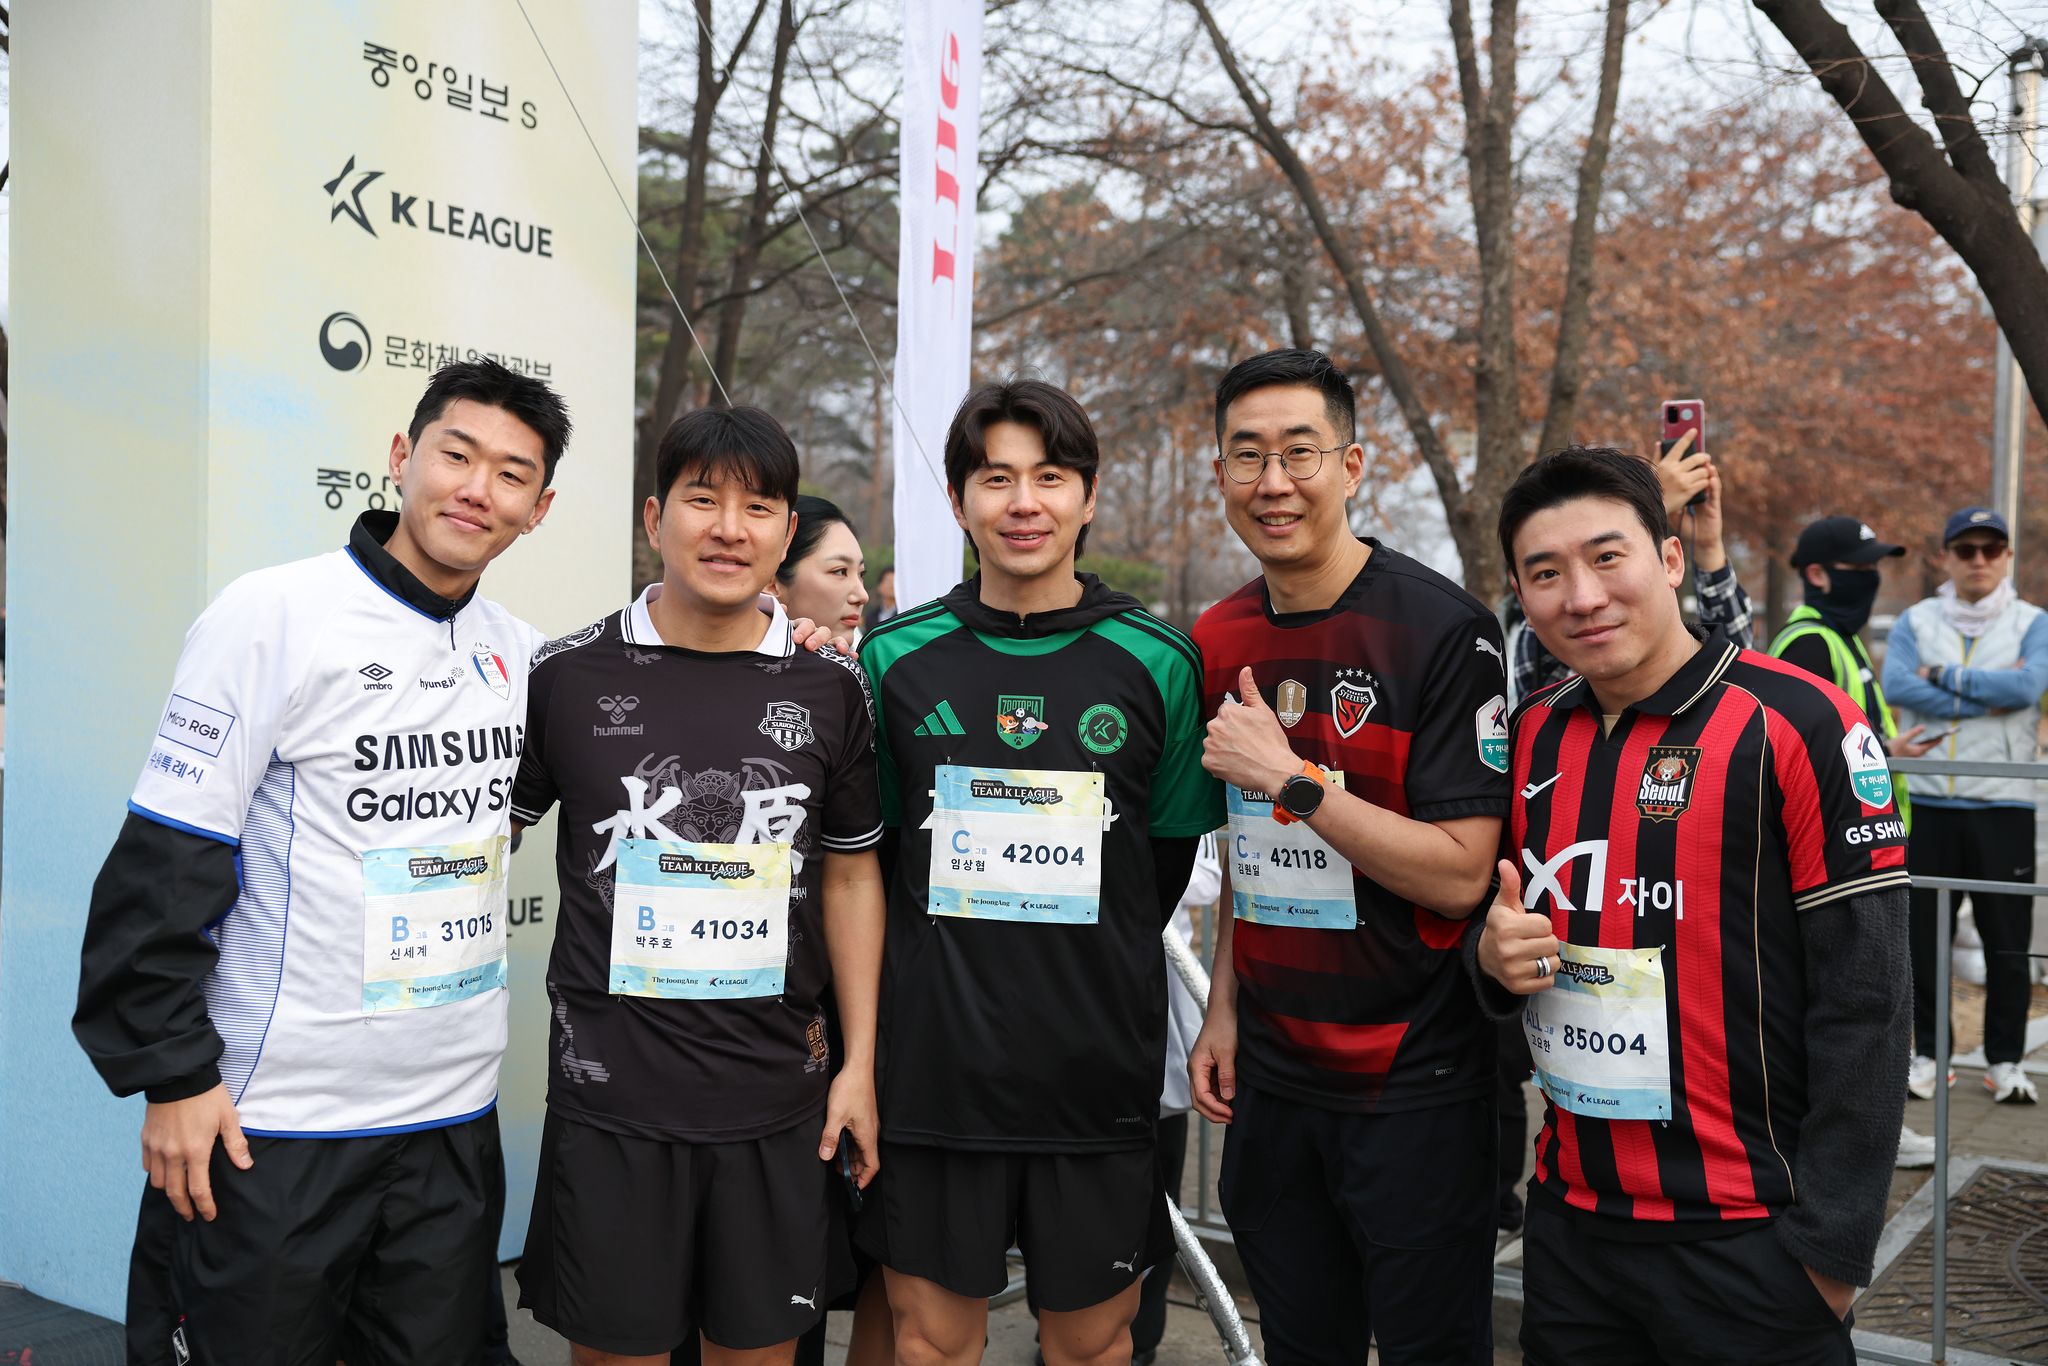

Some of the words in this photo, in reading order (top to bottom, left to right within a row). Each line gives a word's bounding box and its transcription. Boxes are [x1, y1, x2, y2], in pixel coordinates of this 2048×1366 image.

[363, 41, 510, 123] 중앙일보
[521, 101, 538, 130] S
[390, 191, 418, 228] K
[427, 200, 553, 258] LEAGUE
[317, 467, 402, 511] 중앙
[364, 683, 393, 691] umbro
[420, 676, 456, 691] hyungji
[1337, 689, 1370, 704] STEELERS
[1002, 699, 1039, 718] ZOOTOPIA
[189, 720, 220, 740] RGB
[594, 724, 643, 737] hummel
[771, 721, 796, 729] SUWON
[353, 724, 523, 771] SAMSUNG
[150, 751, 204, 784] 수원특례시
[973, 786, 1002, 797] TEAM
[1005, 788, 1013, 797] K
[1014, 788, 1056, 799] LEAGUE
[1242, 790, 1264, 800] TEAM
[1639, 773, 1687, 802] Seoul
[346, 782, 481, 823] Galaxy
[951, 829, 971, 855] C
[1845, 825, 1873, 844] GS
[1002, 843, 1085, 866] 42004
[1236, 834, 1247, 858] C
[411, 864, 442, 876] TEAM
[443, 863, 451, 873] K
[451, 858, 484, 872] LEAGUE
[661, 861, 692, 871] TEAM
[695, 863, 703, 872] K
[704, 863, 748, 873] LEAGUE
[951, 858, 986, 872] 임상협
[1270, 848, 1328, 870] 42118
[1238, 863, 1260, 876] 김원일
[966, 897, 979, 905] The
[980, 898, 1010, 907] JoongAng
[1616, 876, 1684, 920] 자이
[441, 912, 492, 942] 31015
[637, 905, 656, 931] B
[392, 915, 410, 942] B
[690, 919, 769, 940] 41034
[636, 936, 673, 949] 박주호
[390, 945, 427, 960] 신세계
[652, 976, 665, 984] The
[666, 977, 699, 986] JoongAng
[1567, 964, 1606, 979] LEAGUE
[407, 986, 421, 994] The
[422, 982, 452, 994] JoongAng
[1526, 1008, 1543, 1032] ALL
[1531, 1033, 1551, 1053] 고요한
[1563, 1024, 1647, 1055] 85004
[1593, 1098, 1621, 1106] LEAGUE
